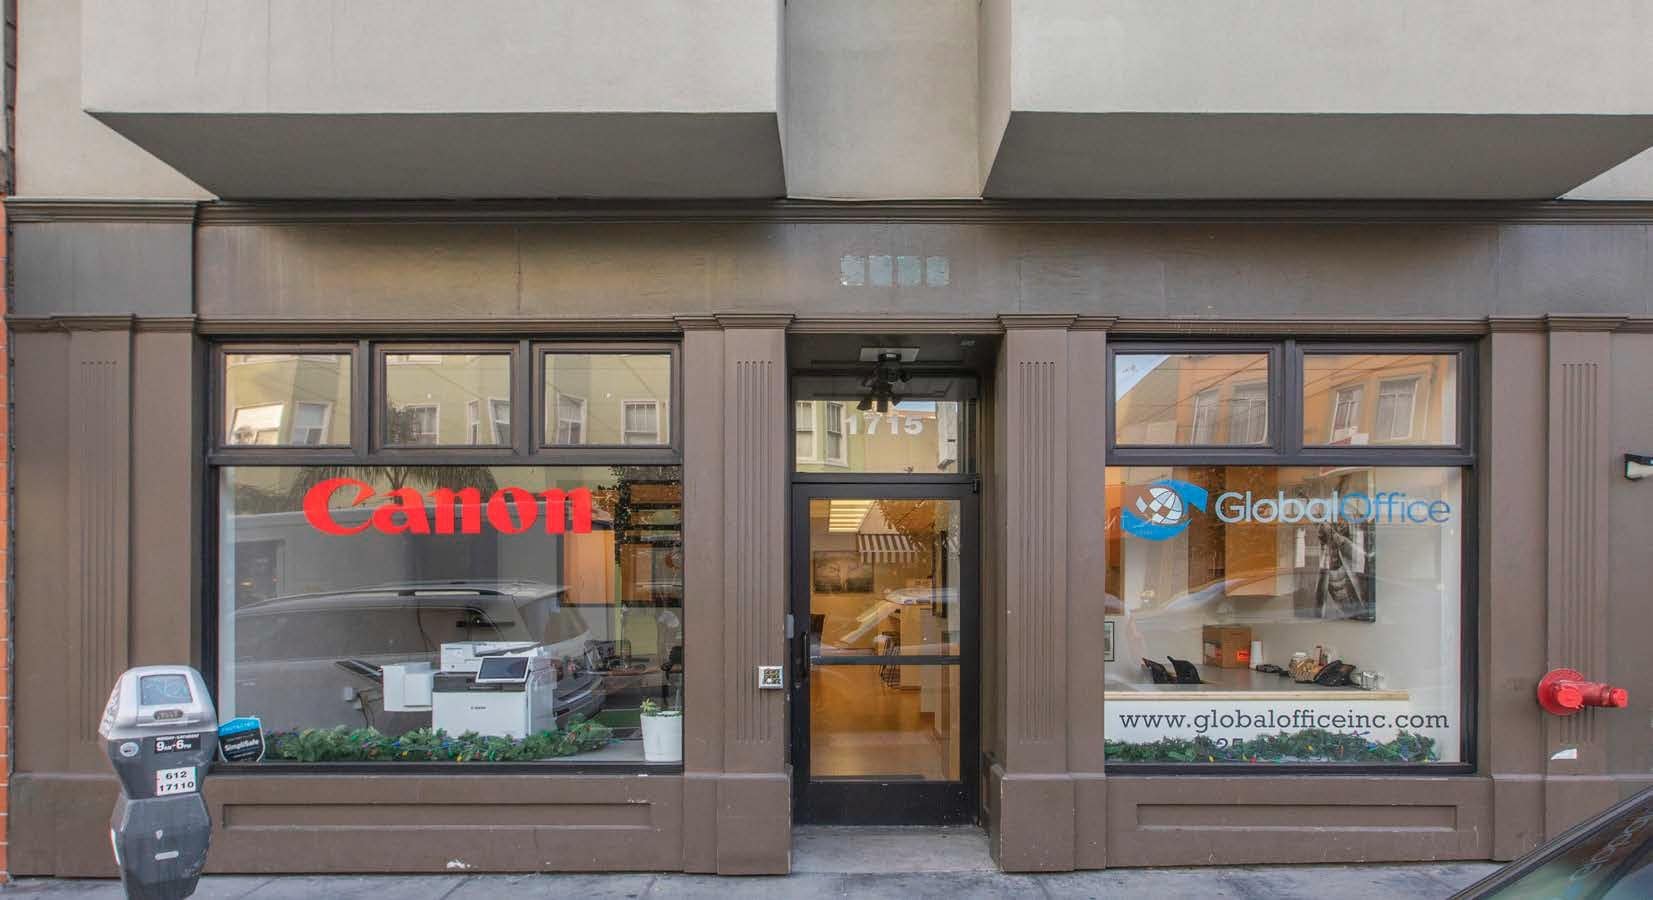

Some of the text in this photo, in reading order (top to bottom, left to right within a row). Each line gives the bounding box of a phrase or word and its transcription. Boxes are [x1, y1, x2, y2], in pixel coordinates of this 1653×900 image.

[845, 416, 923, 435] 1715
[303, 477, 593, 536] Canon
[1215, 490, 1451, 524] GlobalOffice
[1119, 709, 1450, 734] www.globalofficeinc.com
[160, 781, 195, 792] 17110
[166, 771, 187, 780] 612
